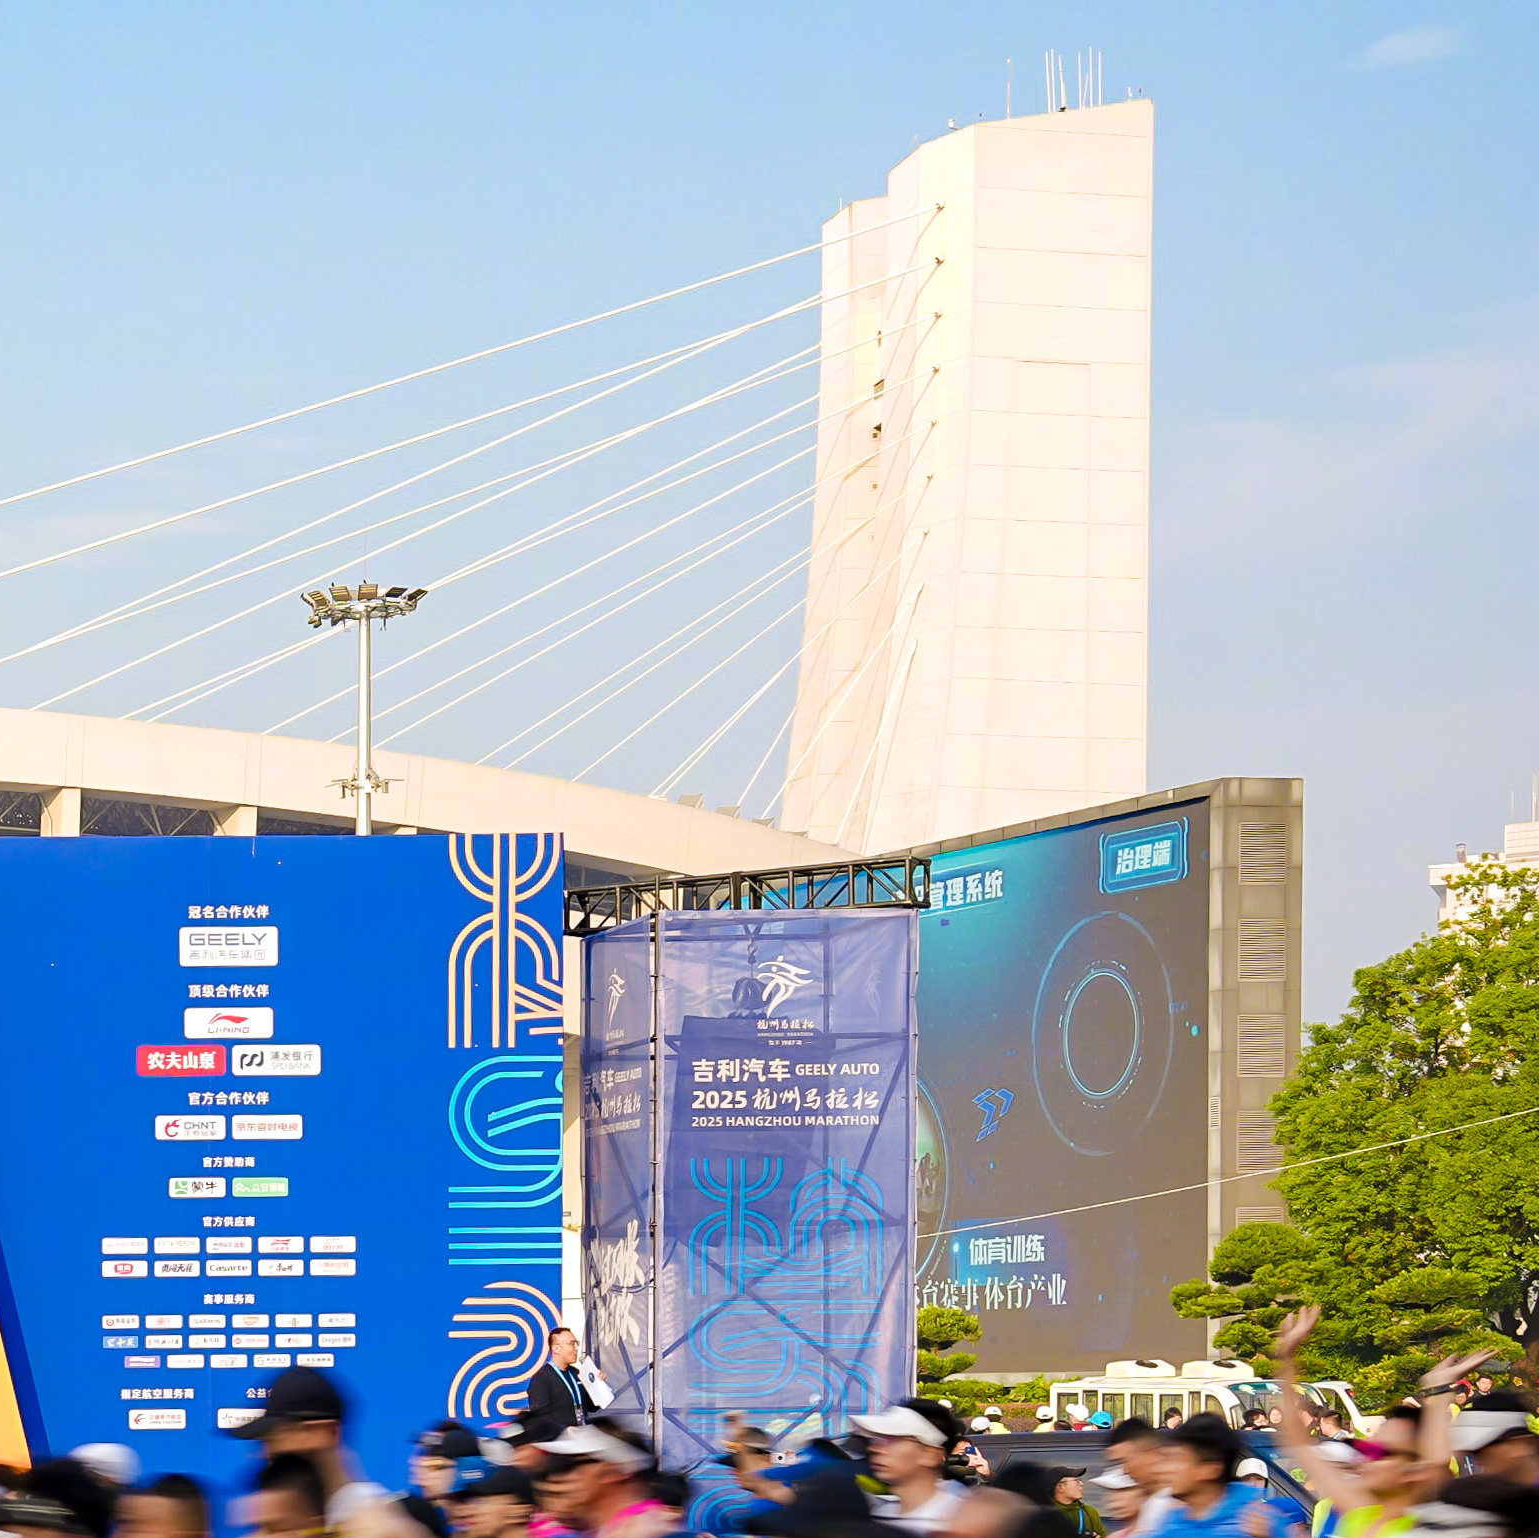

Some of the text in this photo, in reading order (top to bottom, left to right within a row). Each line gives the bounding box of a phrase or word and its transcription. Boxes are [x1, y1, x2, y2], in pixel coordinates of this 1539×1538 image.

[1115, 839, 1172, 875] 治理端
[189, 905, 269, 918] 冠名合作伙伴
[189, 933, 267, 946] GEELY
[188, 984, 269, 997] 顶级合作伙伴
[147, 1051, 215, 1070] 农夫山泉
[270, 1050, 313, 1061] 浦发银行
[692, 1058, 880, 1083] 吉利汽车 GEELY AUTO
[188, 1092, 269, 1105] 官方合作伙伴
[692, 1086, 880, 1112] 2025 杭州马拉松
[692, 1114, 880, 1127] 2025 HANGZHOU MARATHON
[203, 1157, 255, 1167] 官方赞助商
[203, 1216, 255, 1227] 官方供应商
[969, 1234, 1045, 1266] 体育训练
[984, 1273, 1067, 1310] 体育产业
[204, 1294, 255, 1304] 赛事服务商
[121, 1388, 194, 1399] 指定航空服务商
